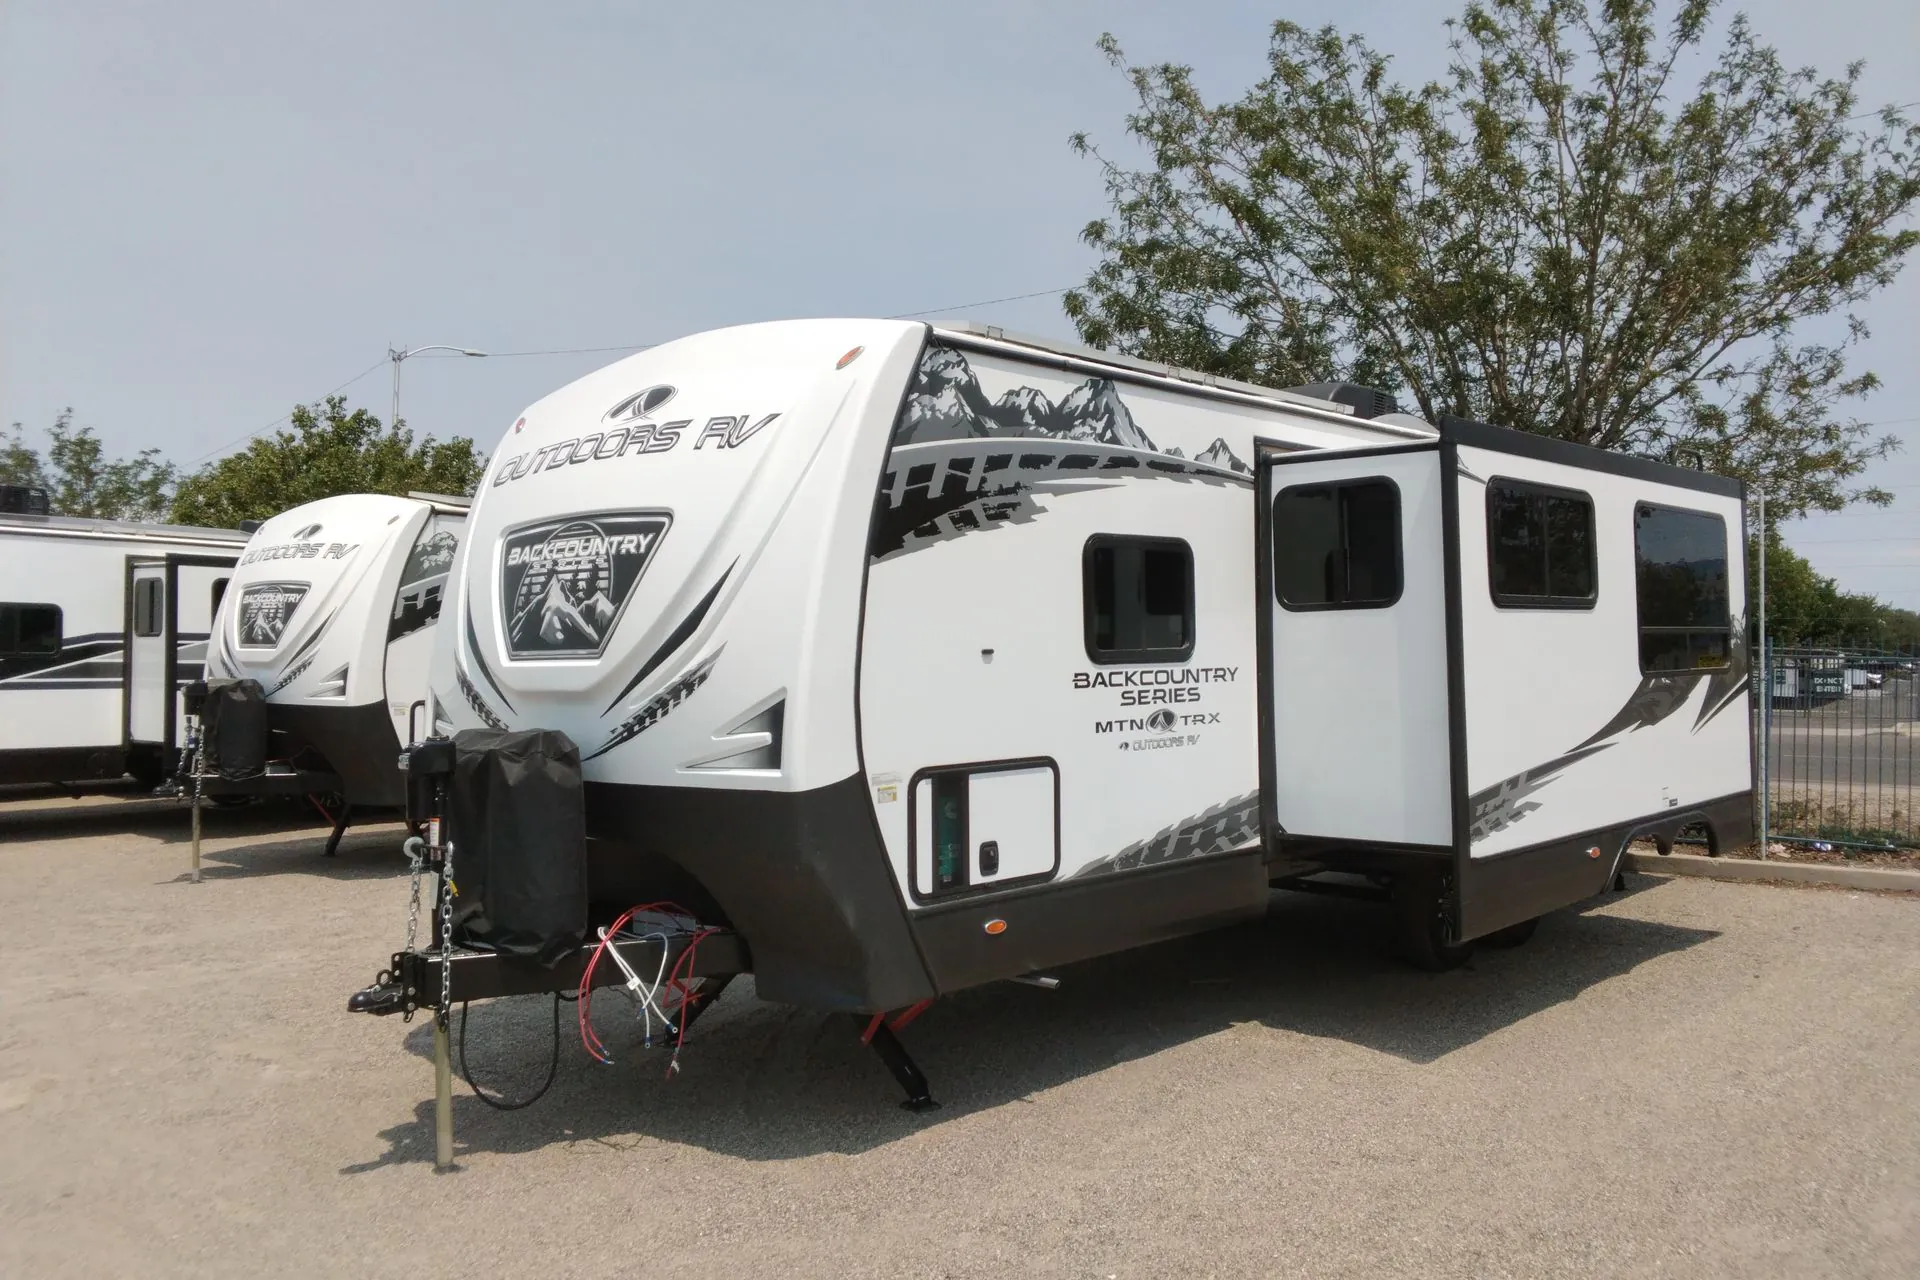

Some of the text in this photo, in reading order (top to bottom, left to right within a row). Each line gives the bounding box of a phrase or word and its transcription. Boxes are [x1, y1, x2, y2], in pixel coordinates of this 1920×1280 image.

[494, 413, 783, 487] OUTDOORS RV
[240, 543, 360, 566] OUTDOORS RV
[507, 532, 656, 566] BACKCOUNTRY
[533, 557, 605, 570] SERIES
[1072, 667, 1239, 689] BACKCOUNTRY
[1120, 687, 1201, 706] SERIES
[1095, 712, 1221, 733] MTN TRX
[1133, 734, 1201, 751] OUTDOORS RV
